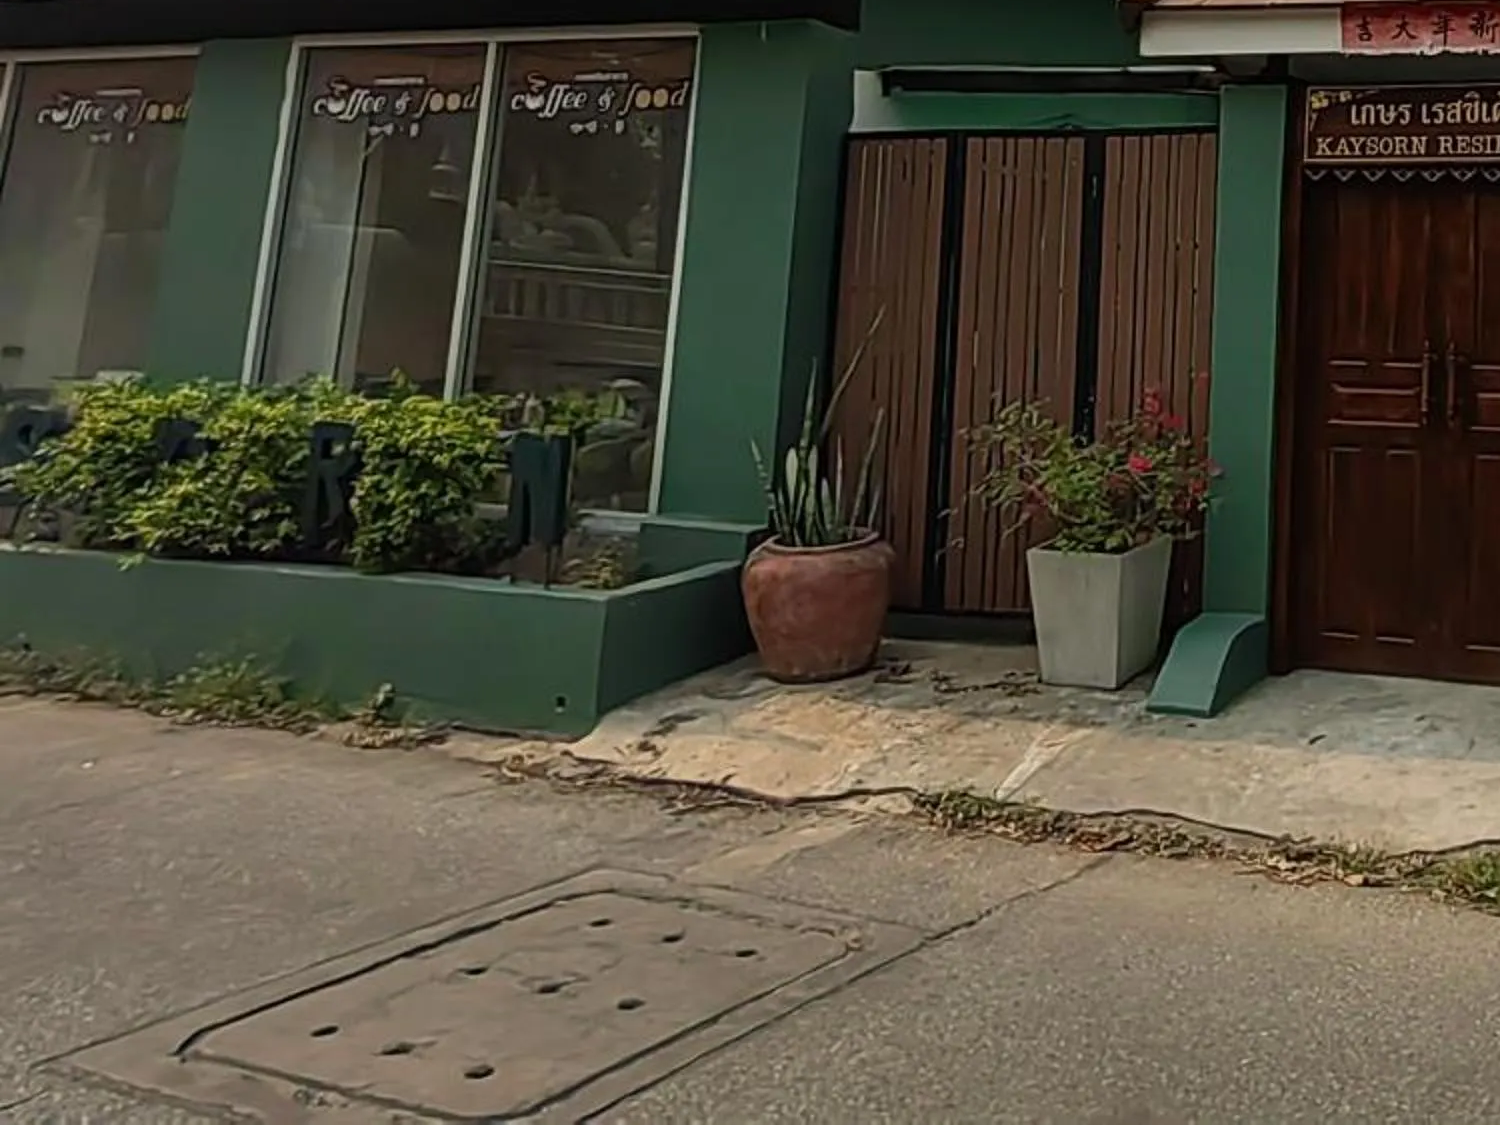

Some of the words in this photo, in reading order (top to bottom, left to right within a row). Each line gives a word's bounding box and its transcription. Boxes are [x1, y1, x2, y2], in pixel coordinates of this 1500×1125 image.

[413, 84, 481, 119] food
[617, 80, 690, 116] food
[1350, 102, 1413, 126] เกษร
[1315, 135, 1429, 157] KAYSORN
